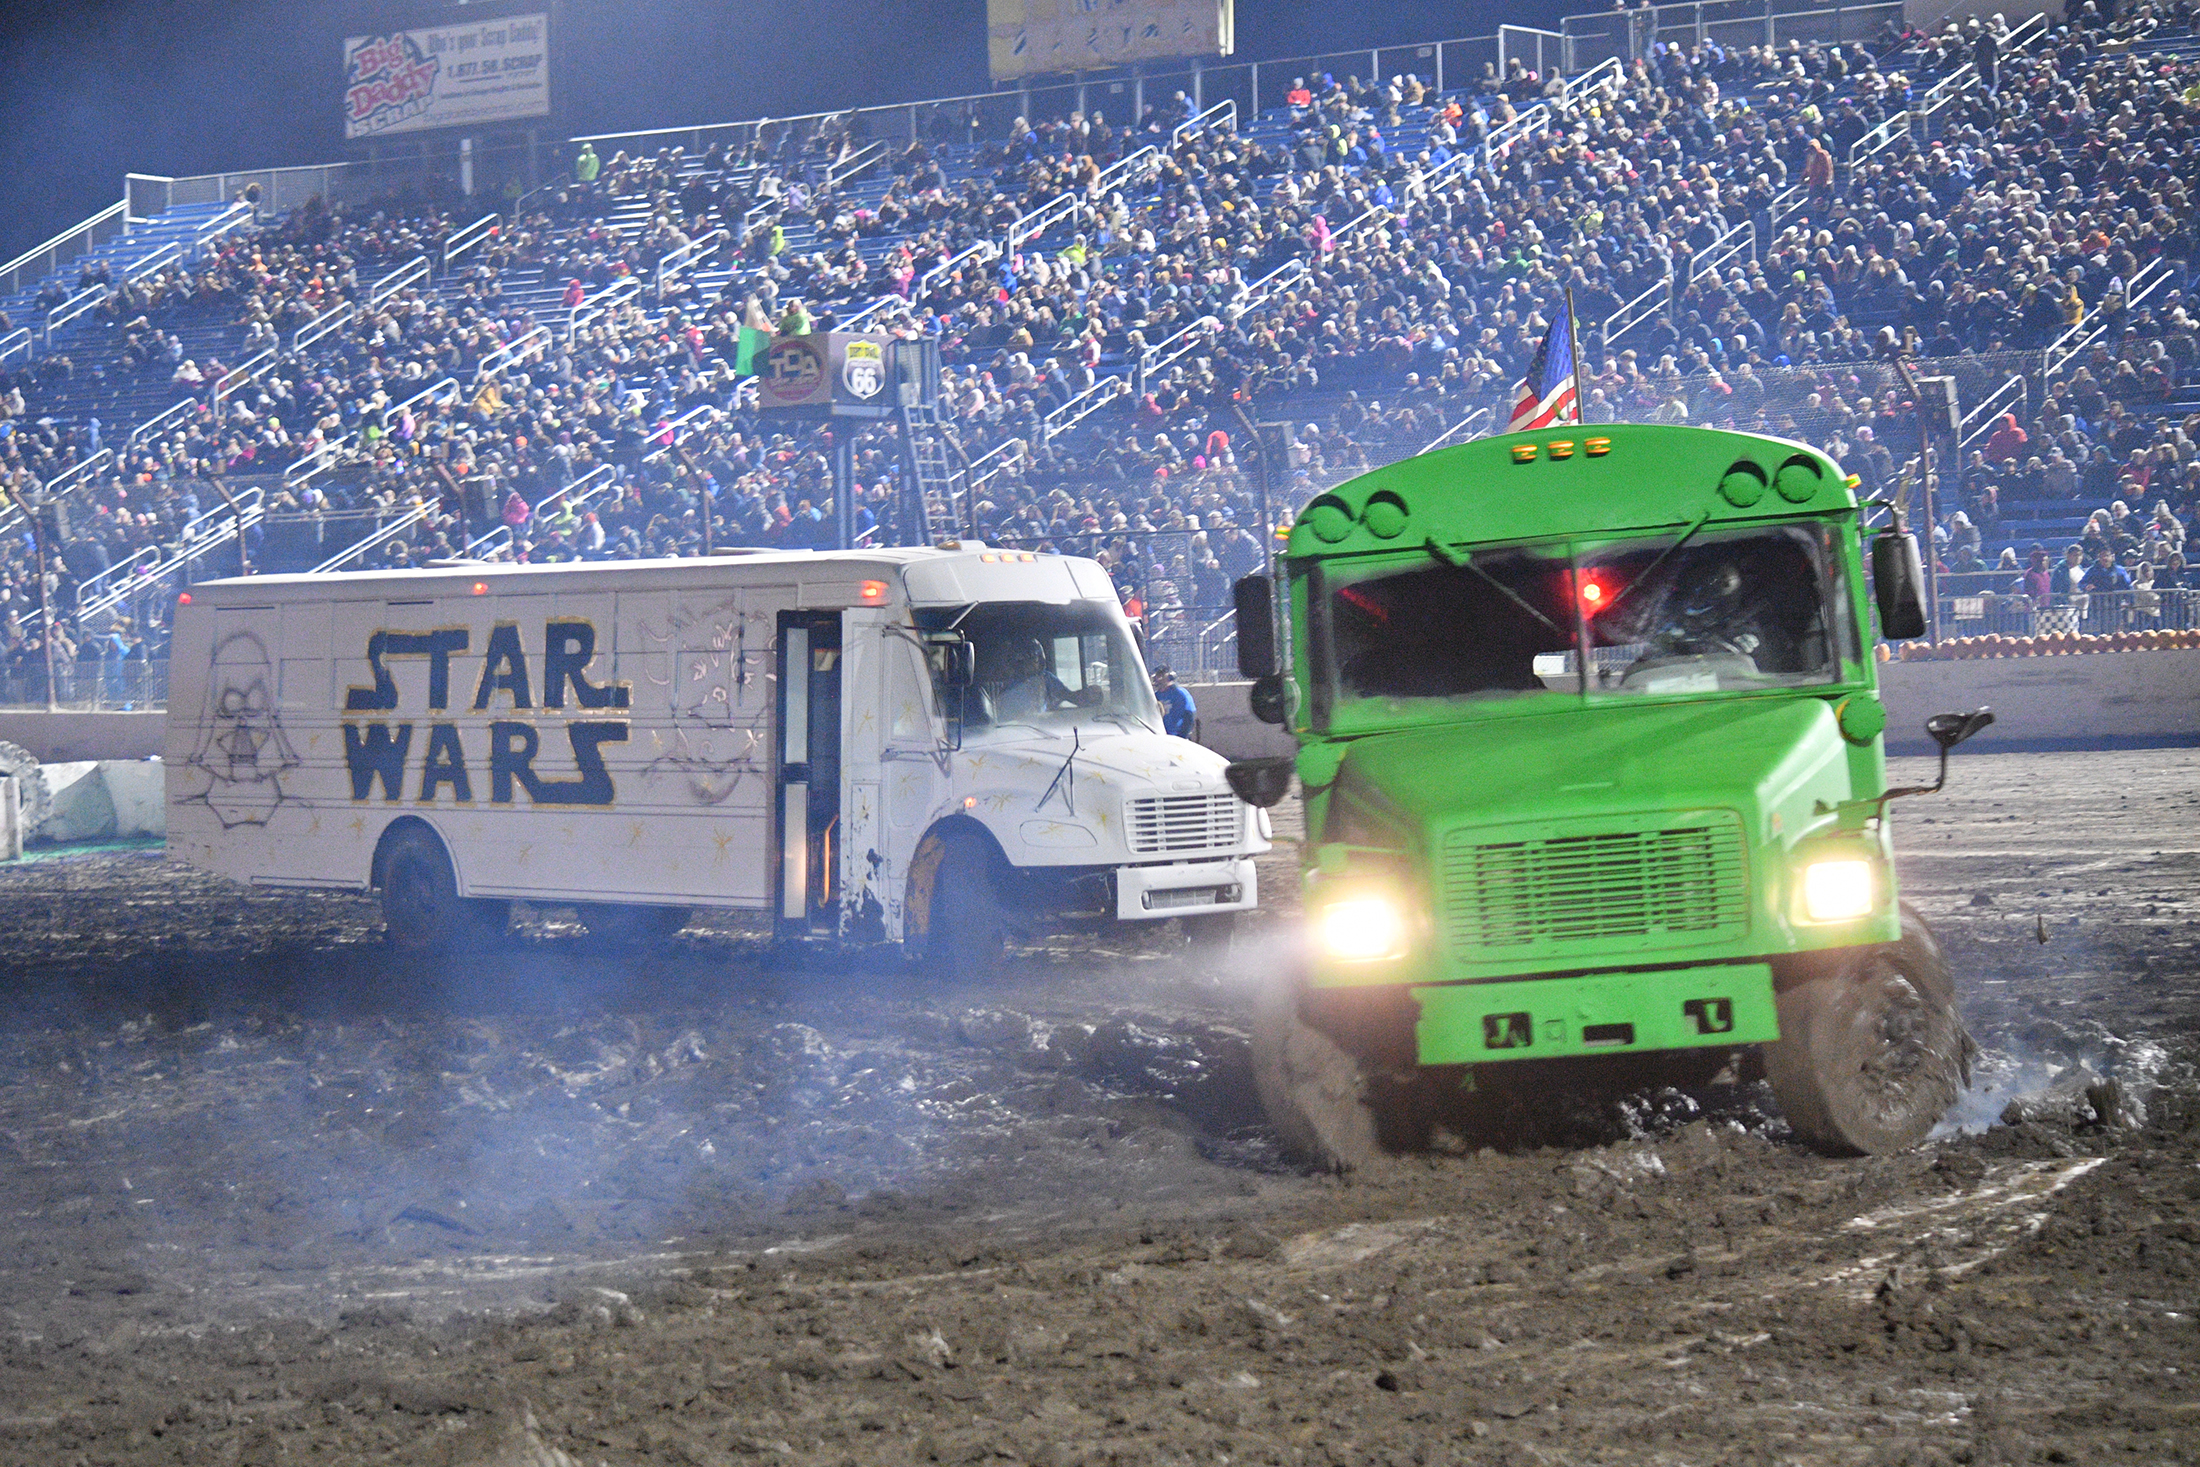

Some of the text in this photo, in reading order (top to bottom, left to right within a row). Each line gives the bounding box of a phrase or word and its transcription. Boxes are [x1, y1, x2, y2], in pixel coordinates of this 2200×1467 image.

[355, 34, 404, 77] Big
[350, 62, 435, 117] Daddy
[353, 96, 434, 136] SCRAP
[851, 367, 877, 394] 66
[345, 617, 633, 714] STAR
[342, 720, 631, 809] WARS
